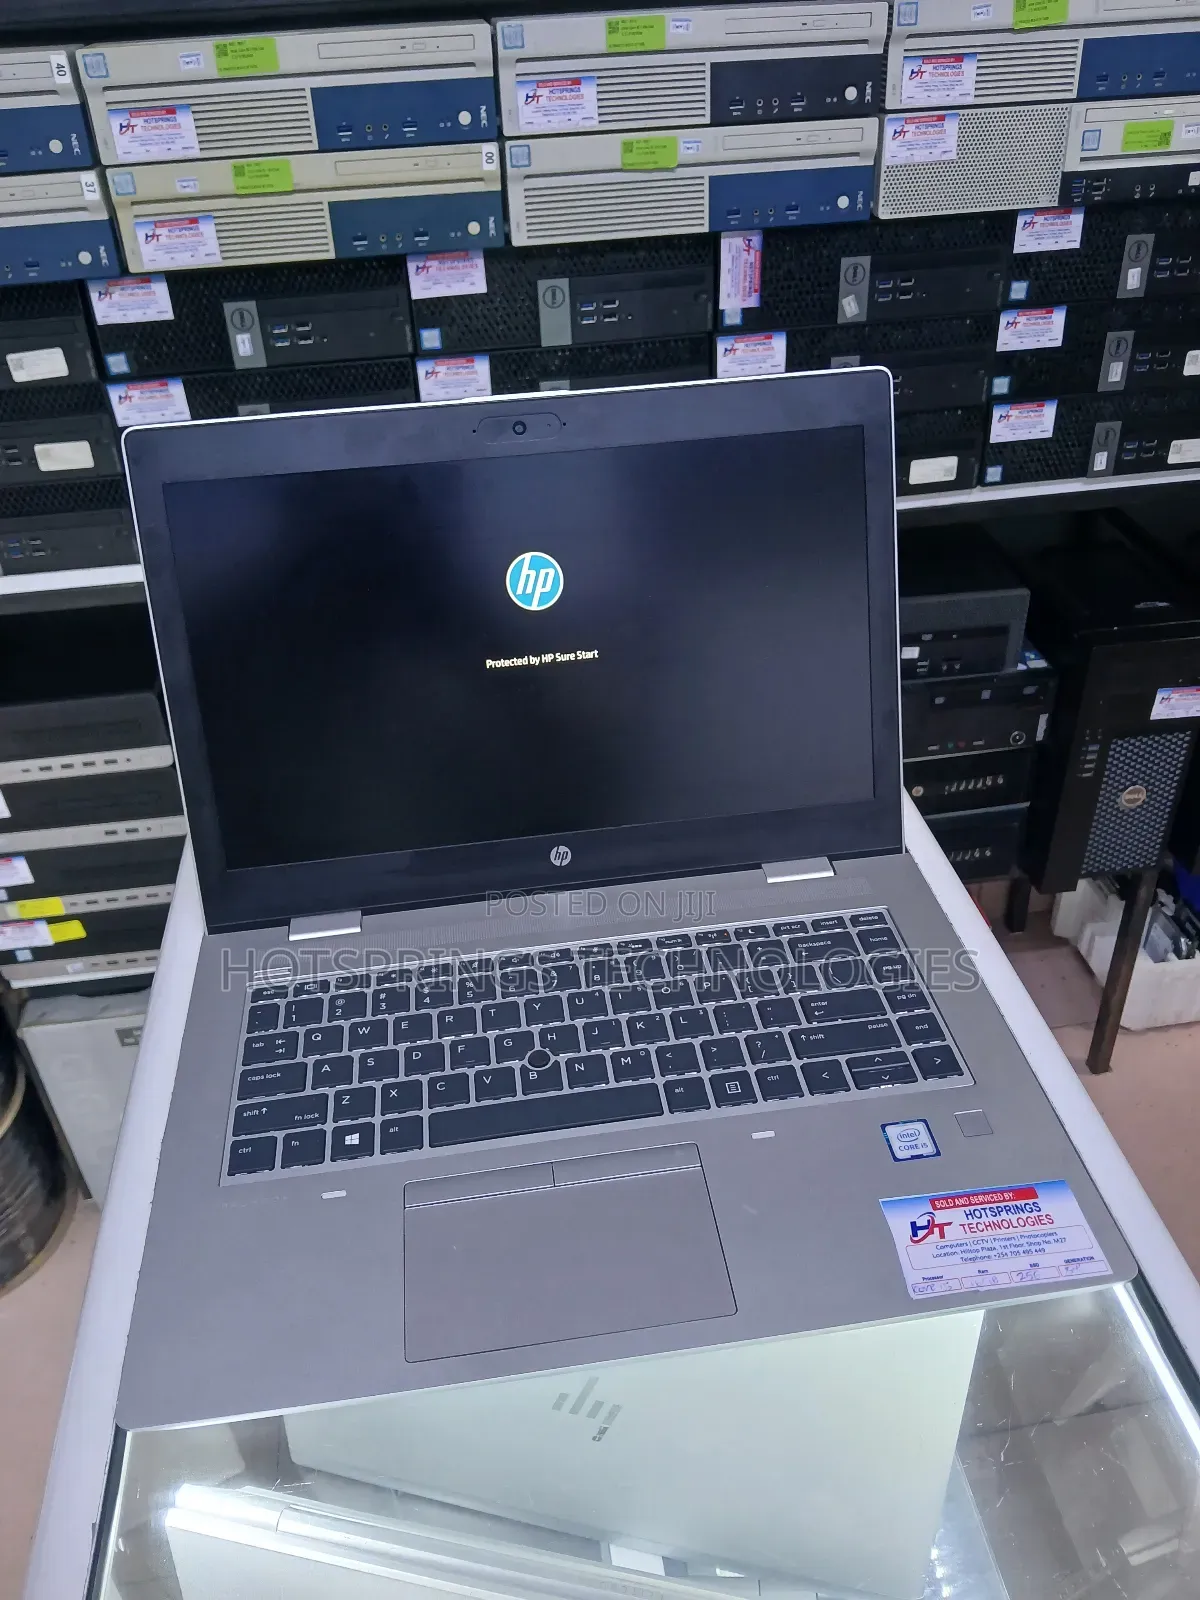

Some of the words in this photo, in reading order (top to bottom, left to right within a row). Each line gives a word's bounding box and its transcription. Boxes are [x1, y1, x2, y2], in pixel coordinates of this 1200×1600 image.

[56, 62, 66, 77] 40
[549, 86, 581, 94] HOTSPRINGS
[546, 94, 584, 102] TECHNOLOGIES
[70, 133, 81, 156] NEC
[84, 181, 96, 194] 37
[488, 216, 496, 237] NEC
[99, 245, 110, 267] NEC
[512, 552, 559, 610] hp
[486, 656, 528, 669] Protected
[529, 655, 540, 666] by
[542, 653, 554, 664] HP
[556, 651, 575, 662] Sure
[577, 649, 599, 660] Start
[552, 846, 570, 866] hp
[533, 1002, 541, 1010] Y
[358, 1026, 370, 1034] W
[547, 1032, 556, 1040] H
[504, 1038, 513, 1046] G
[458, 1045, 466, 1053] F
[621, 1057, 632, 1065] M
[575, 1063, 584, 1071] N
[482, 1076, 492, 1084] V
[529, 1072, 538, 1080] B
[436, 1082, 446, 1090] C
[390, 1089, 398, 1098] X
[342, 1096, 350, 1104] Z
[899, 1130, 917, 1139] intel
[898, 1144, 919, 1152] CORE
[934, 1199, 954, 1208] SOLD
[955, 1197, 970, 1206] AND
[970, 1193, 1004, 1205] SERVICED
[964, 1202, 1042, 1220] HOTSPRINGS
[959, 1213, 1054, 1234] TECHNOLOGIES
[936, 1241, 968, 1251] Computers
[1020, 1232, 1058, 1241] Photocopiers
[960, 1247, 980, 1255] Hilltop
